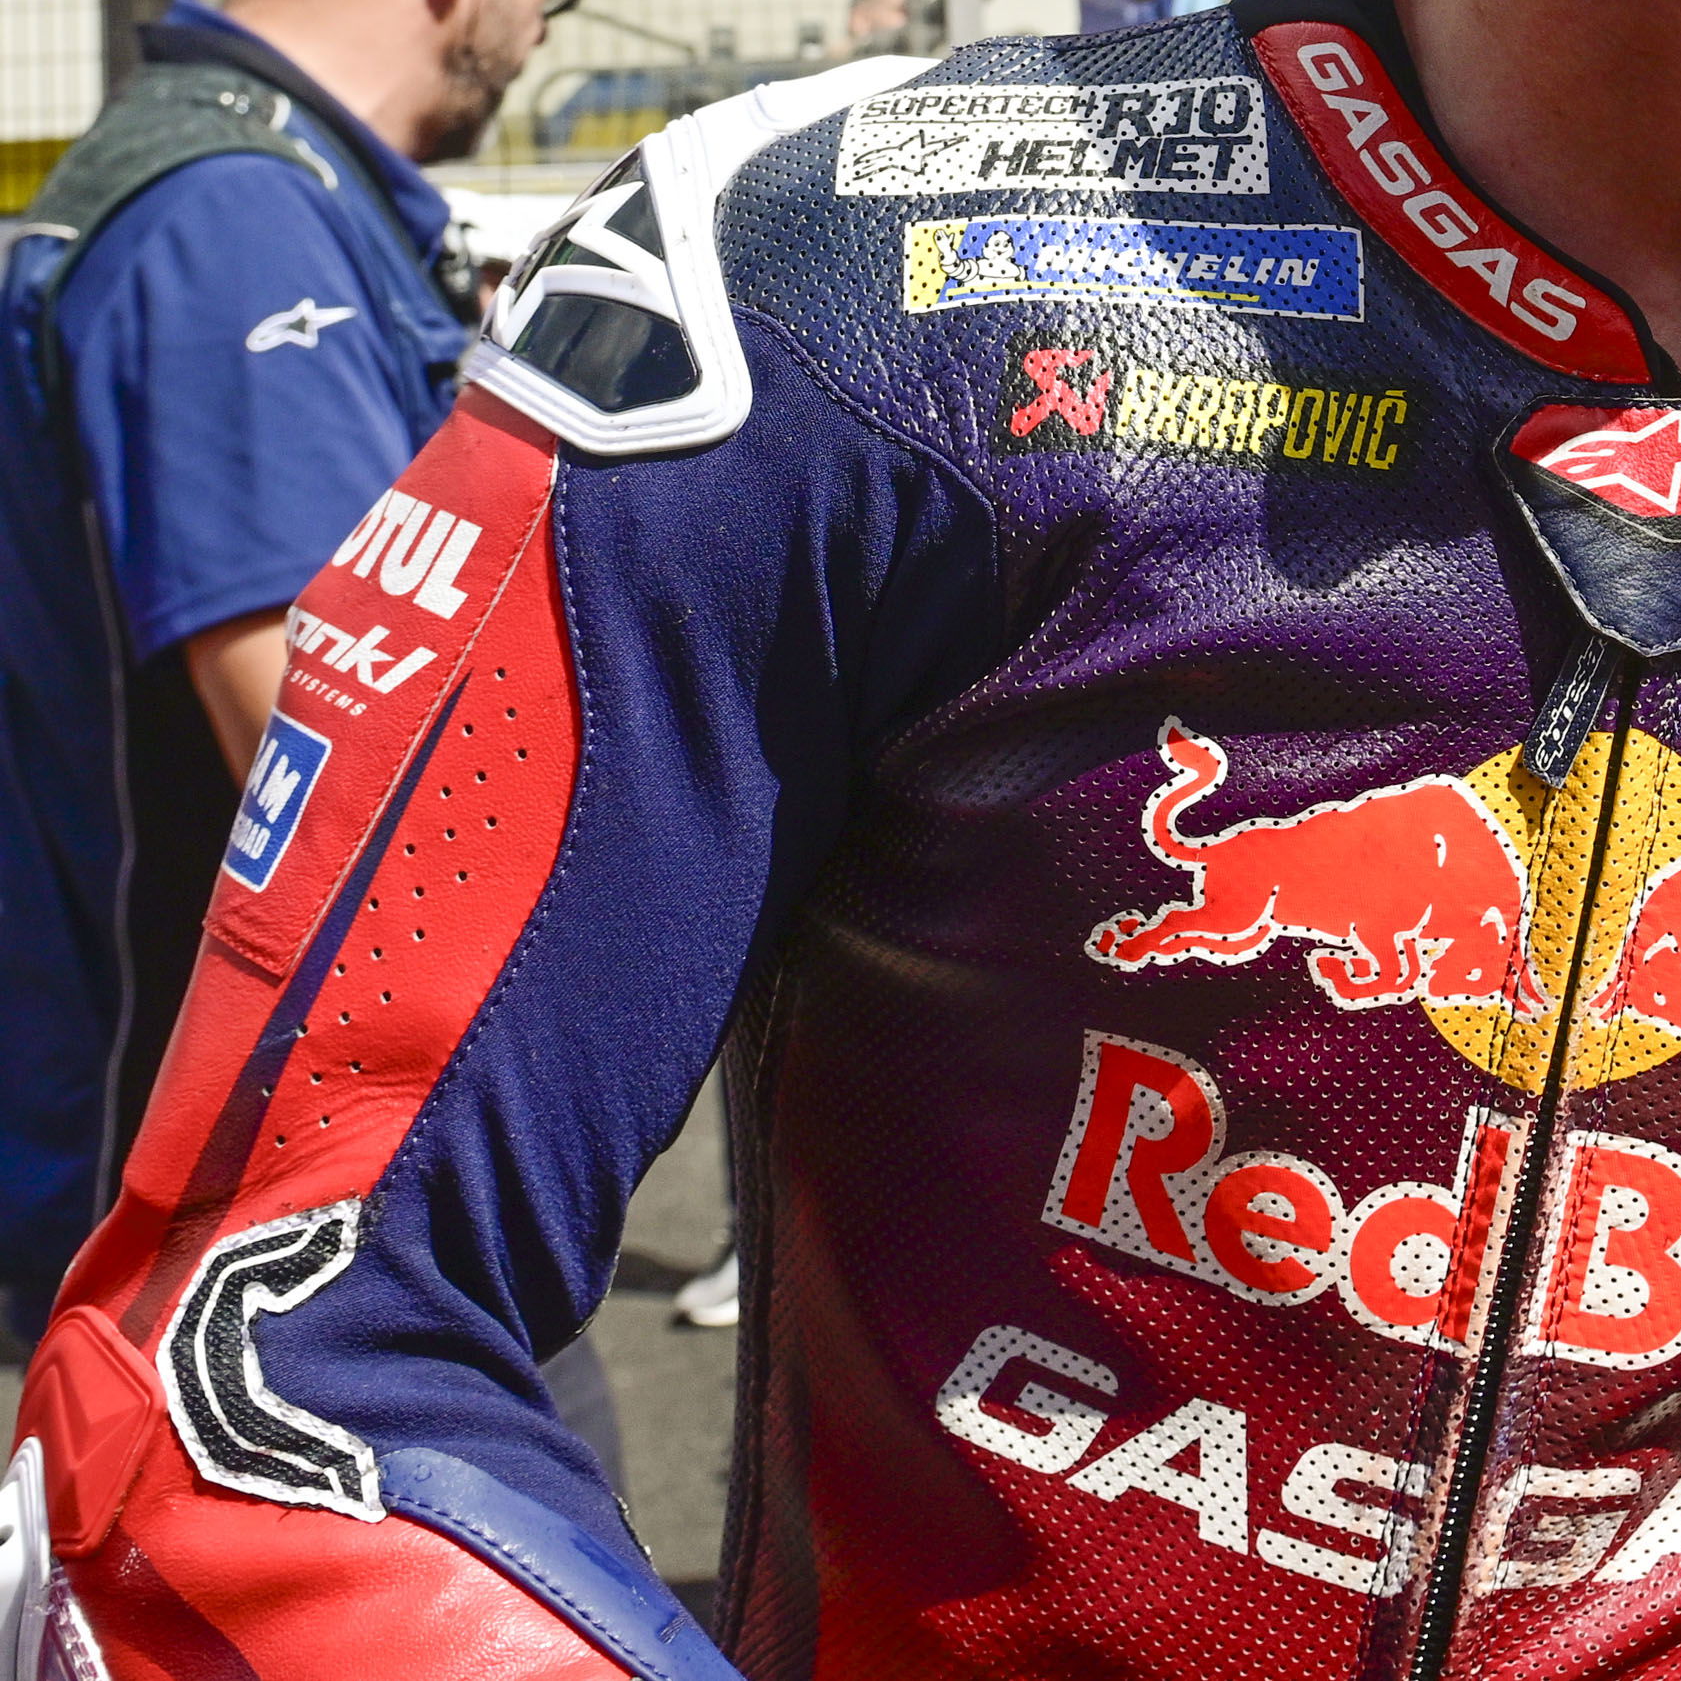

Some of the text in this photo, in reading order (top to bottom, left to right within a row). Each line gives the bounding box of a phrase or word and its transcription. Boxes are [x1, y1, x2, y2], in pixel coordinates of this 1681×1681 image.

[861, 84, 1254, 139] SUPERTECH R10
[976, 134, 1254, 183] HELMET
[1297, 42, 1587, 341] GASGAS
[1033, 239, 1320, 287] MICHELIN
[290, 669, 367, 716] SYSTEMS
[1041, 1027, 1530, 1355] Red
